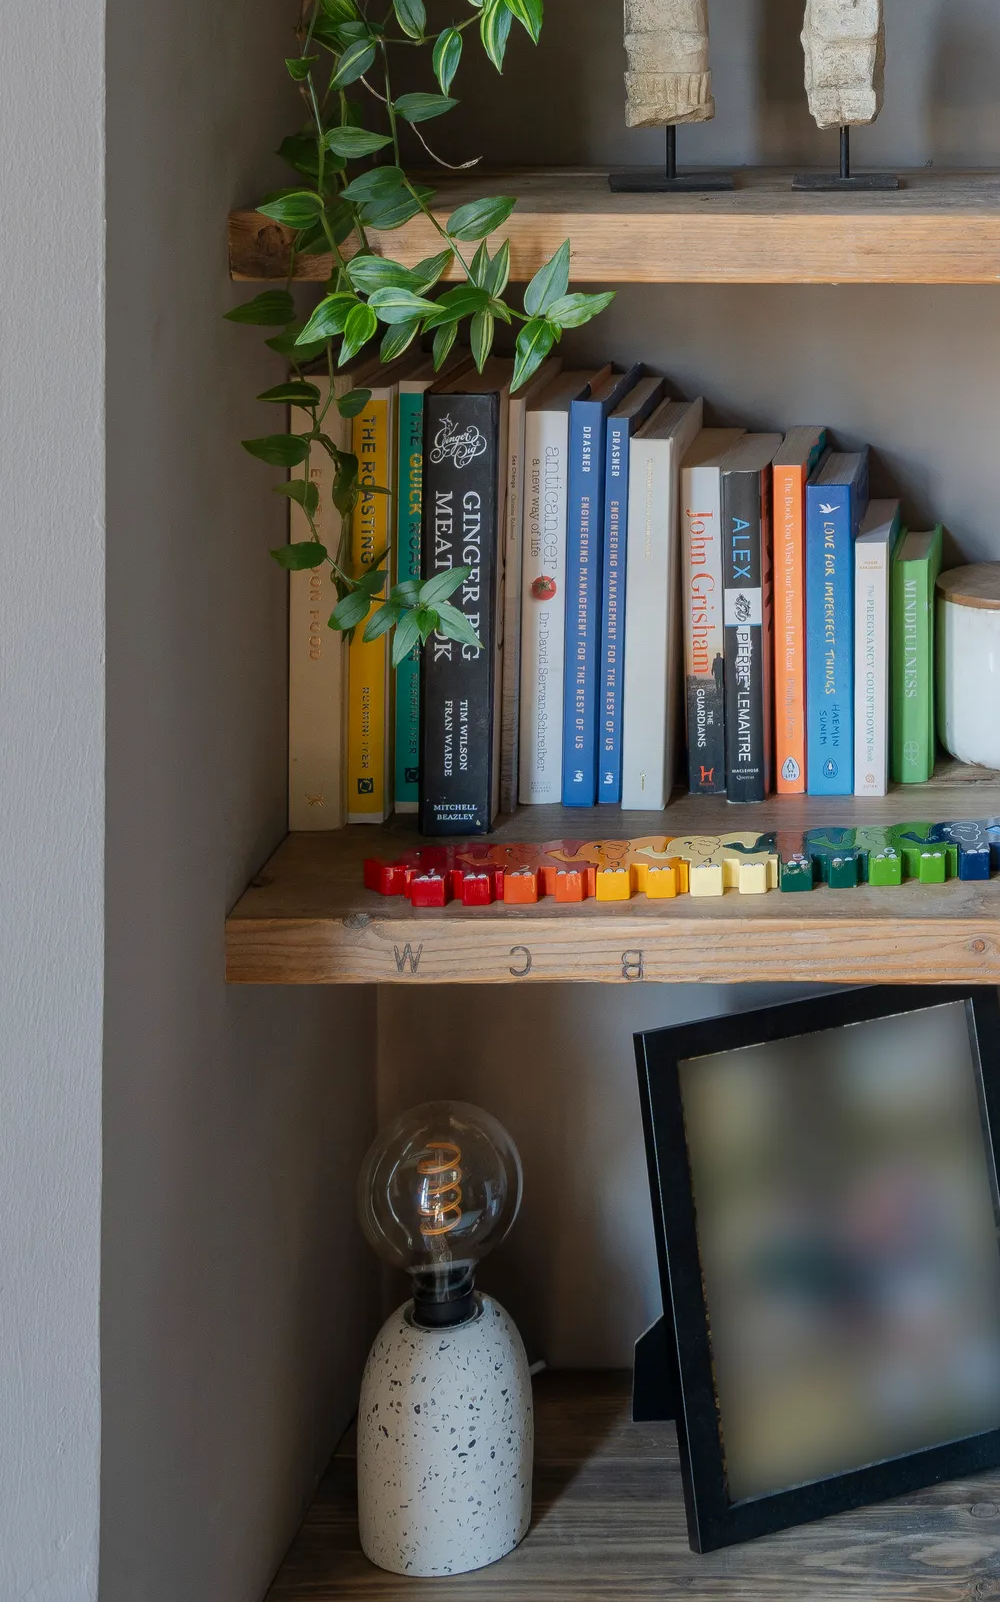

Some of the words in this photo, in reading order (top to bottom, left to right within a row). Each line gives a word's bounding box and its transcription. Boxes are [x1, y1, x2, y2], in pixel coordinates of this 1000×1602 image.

[360, 416, 376, 454] THE
[582, 426, 592, 472] DRASNER
[532, 458, 540, 466] a
[612, 431, 620, 477] DRASNER
[408, 453, 422, 516] QUICK
[532, 470, 540, 493] new
[784, 477, 793, 494] The
[360, 462, 376, 565] ROASTING
[530, 496, 540, 520] way
[544, 446, 562, 570] anticancer
[784, 496, 794, 521] Book
[434, 490, 453, 569] MEAT
[532, 524, 540, 535] of
[580, 496, 590, 563] ENGINEERING
[610, 501, 619, 567] ENGINEERING
[686, 509, 714, 566] John
[784, 522, 794, 540] You
[824, 522, 835, 548] LOVE
[462, 490, 480, 605] GINGER
[531, 538, 541, 557] life
[732, 517, 750, 579] ALEX
[785, 541, 794, 564] Wish
[785, 567, 794, 588] Your
[824, 554, 836, 576] FOR
[577, 568, 588, 636] MANAGEMENT
[608, 572, 618, 640] MANAGEMENT
[786, 590, 794, 624] Parents
[824, 582, 836, 644] IMPERFECT
[539, 612, 550, 627] Dr
[690, 573, 716, 674] Grisham
[786, 626, 795, 645] Had
[866, 599, 875, 668] PREGNANCY
[538, 632, 550, 664] David
[577, 642, 586, 660] FOR
[607, 645, 616, 663] FOR
[904, 580, 918, 698] MINDFULNESS
[576, 666, 586, 684] THE
[736, 631, 751, 686] PIERRE
[786, 648, 795, 671] Read
[824, 649, 836, 695] THINGS
[606, 668, 616, 687] THE
[444, 700, 453, 731] FRAN
[460, 700, 468, 722] TIM
[576, 689, 585, 714] REST
[606, 692, 614, 716] REST
[696, 688, 706, 748] GUARDIANS
[866, 671, 875, 744] COUNTDOWN
[536, 668, 550, 771] Servan-Schreiber
[576, 718, 584, 730] OF
[606, 720, 614, 733] OF
[738, 692, 751, 762] LEMAITRE
[820, 710, 828, 746] SUNIM
[832, 704, 840, 747] HAEMIN
[444, 734, 453, 776] WARDE
[459, 724, 468, 771] WILSON
[575, 735, 584, 749] US
[605, 738, 614, 751] US
